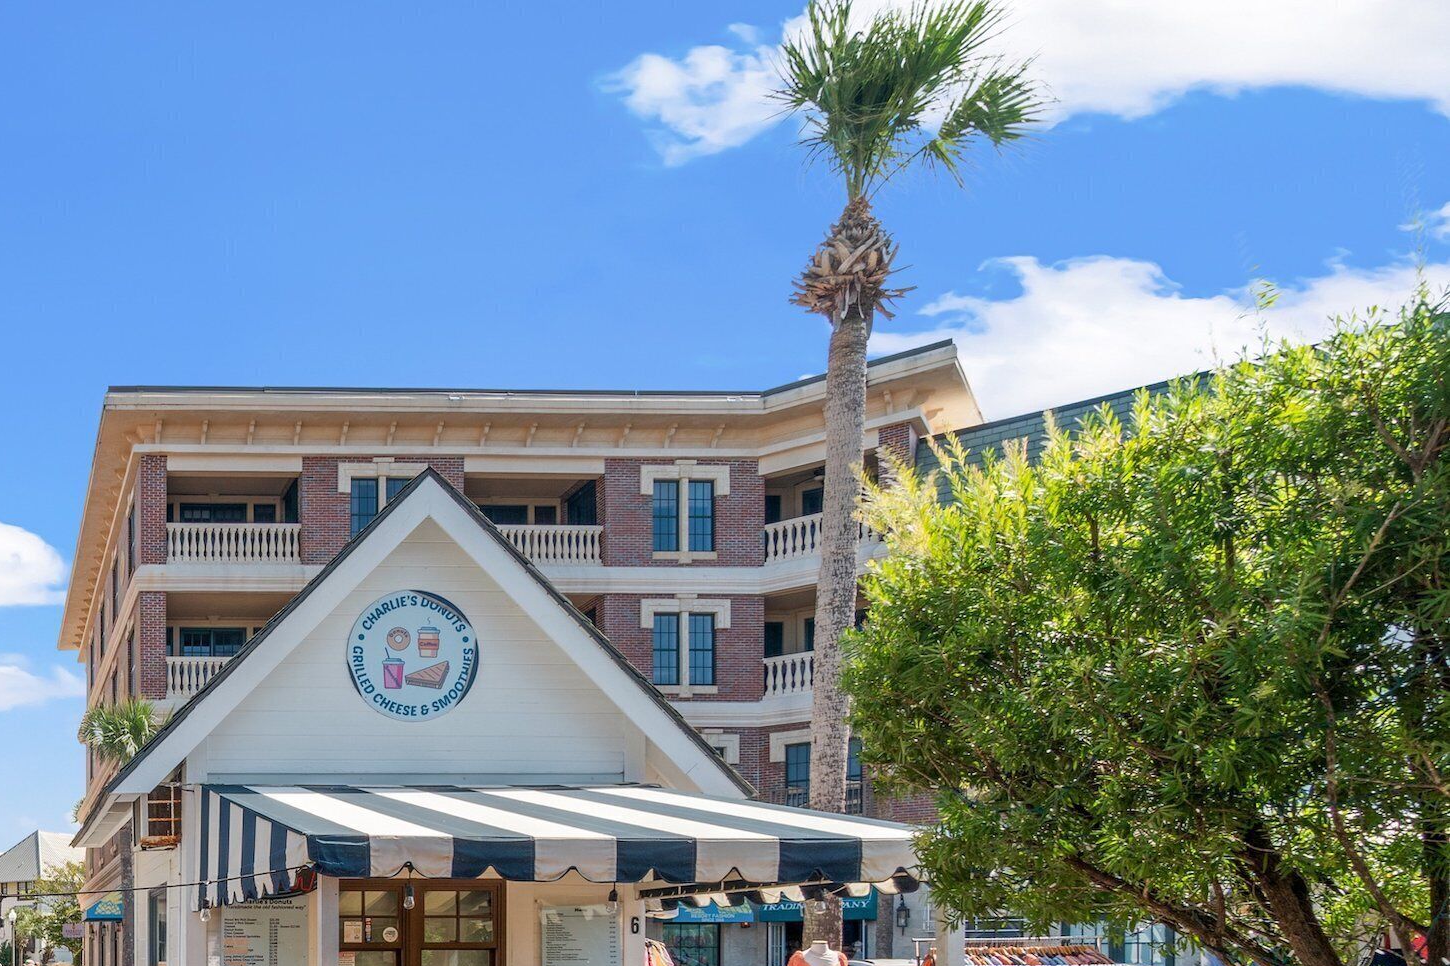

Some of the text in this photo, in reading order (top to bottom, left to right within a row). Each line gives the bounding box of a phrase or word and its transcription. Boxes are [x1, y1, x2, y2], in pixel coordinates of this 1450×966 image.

[362, 596, 466, 633] CHARLIE'S DONUTS
[353, 646, 474, 716] GRILLED CHEESE & SMOOTHIES
[630, 916, 640, 934] 6
